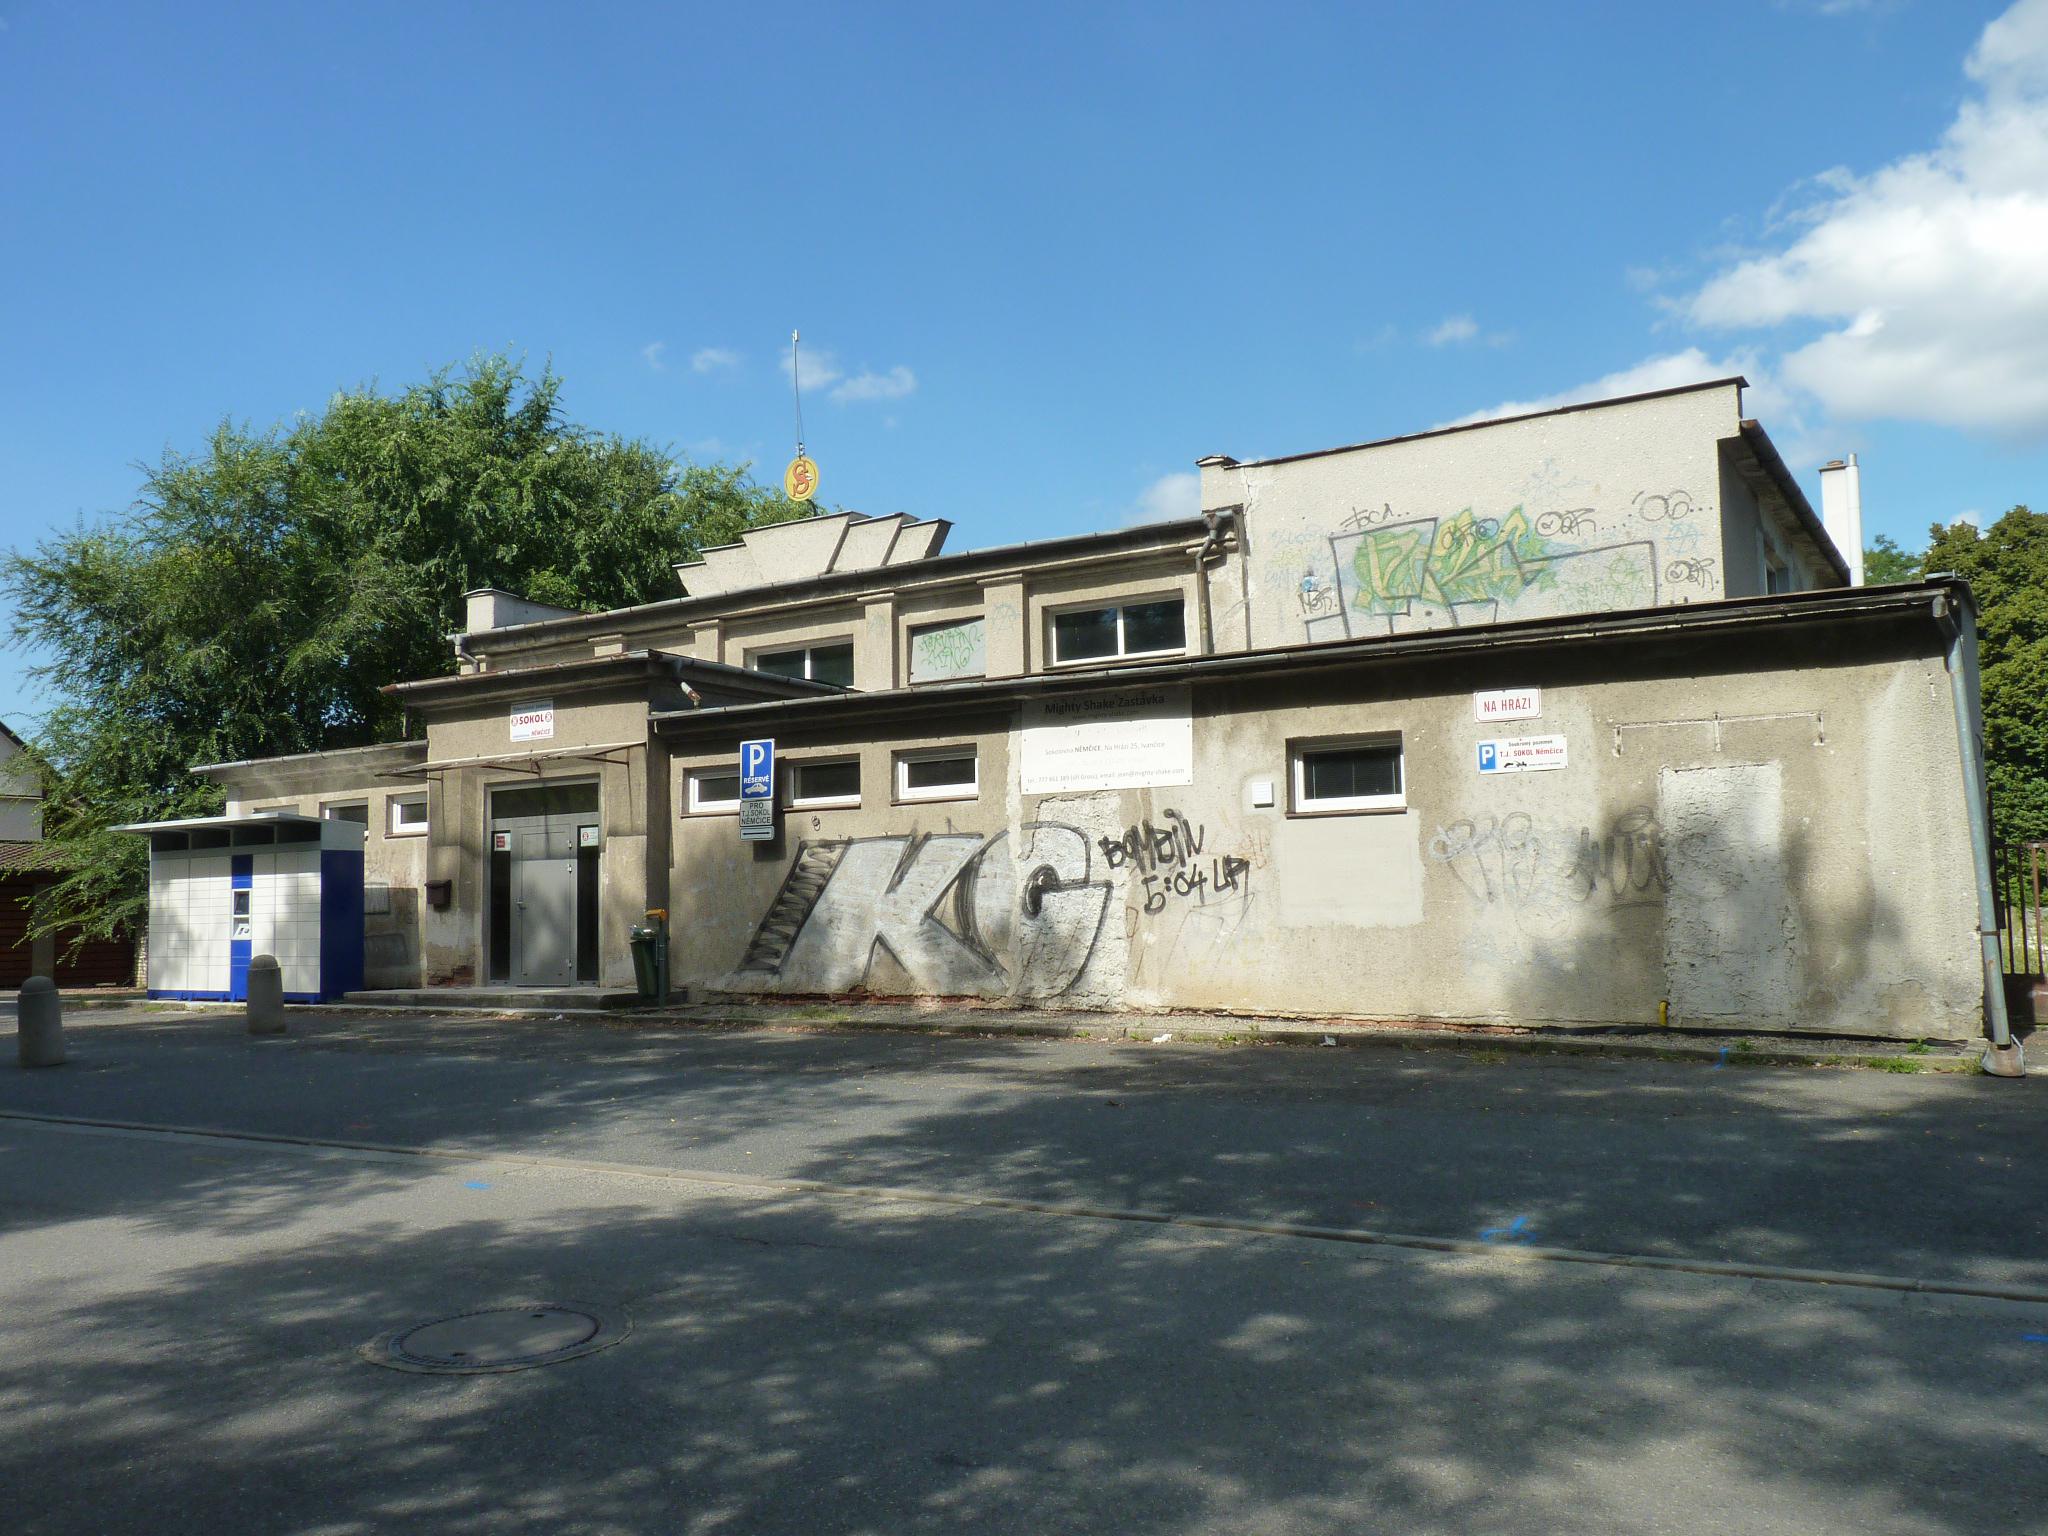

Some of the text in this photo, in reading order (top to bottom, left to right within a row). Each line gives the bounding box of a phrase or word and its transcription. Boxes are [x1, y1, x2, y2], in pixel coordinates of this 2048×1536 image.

[1045, 694, 1165, 715] Mighty Shake Zastávka
[1484, 697, 1531, 713] NA HRÁZI
[519, 713, 544, 725] SOKOL
[1482, 746, 1494, 765] P
[1513, 749, 1534, 757] SOKOL
[1535, 747, 1564, 755] Němčice
[749, 744, 765, 777] P
[743, 775, 770, 784] RÉSERVÉ
[741, 816, 771, 825] NĚMČICE
